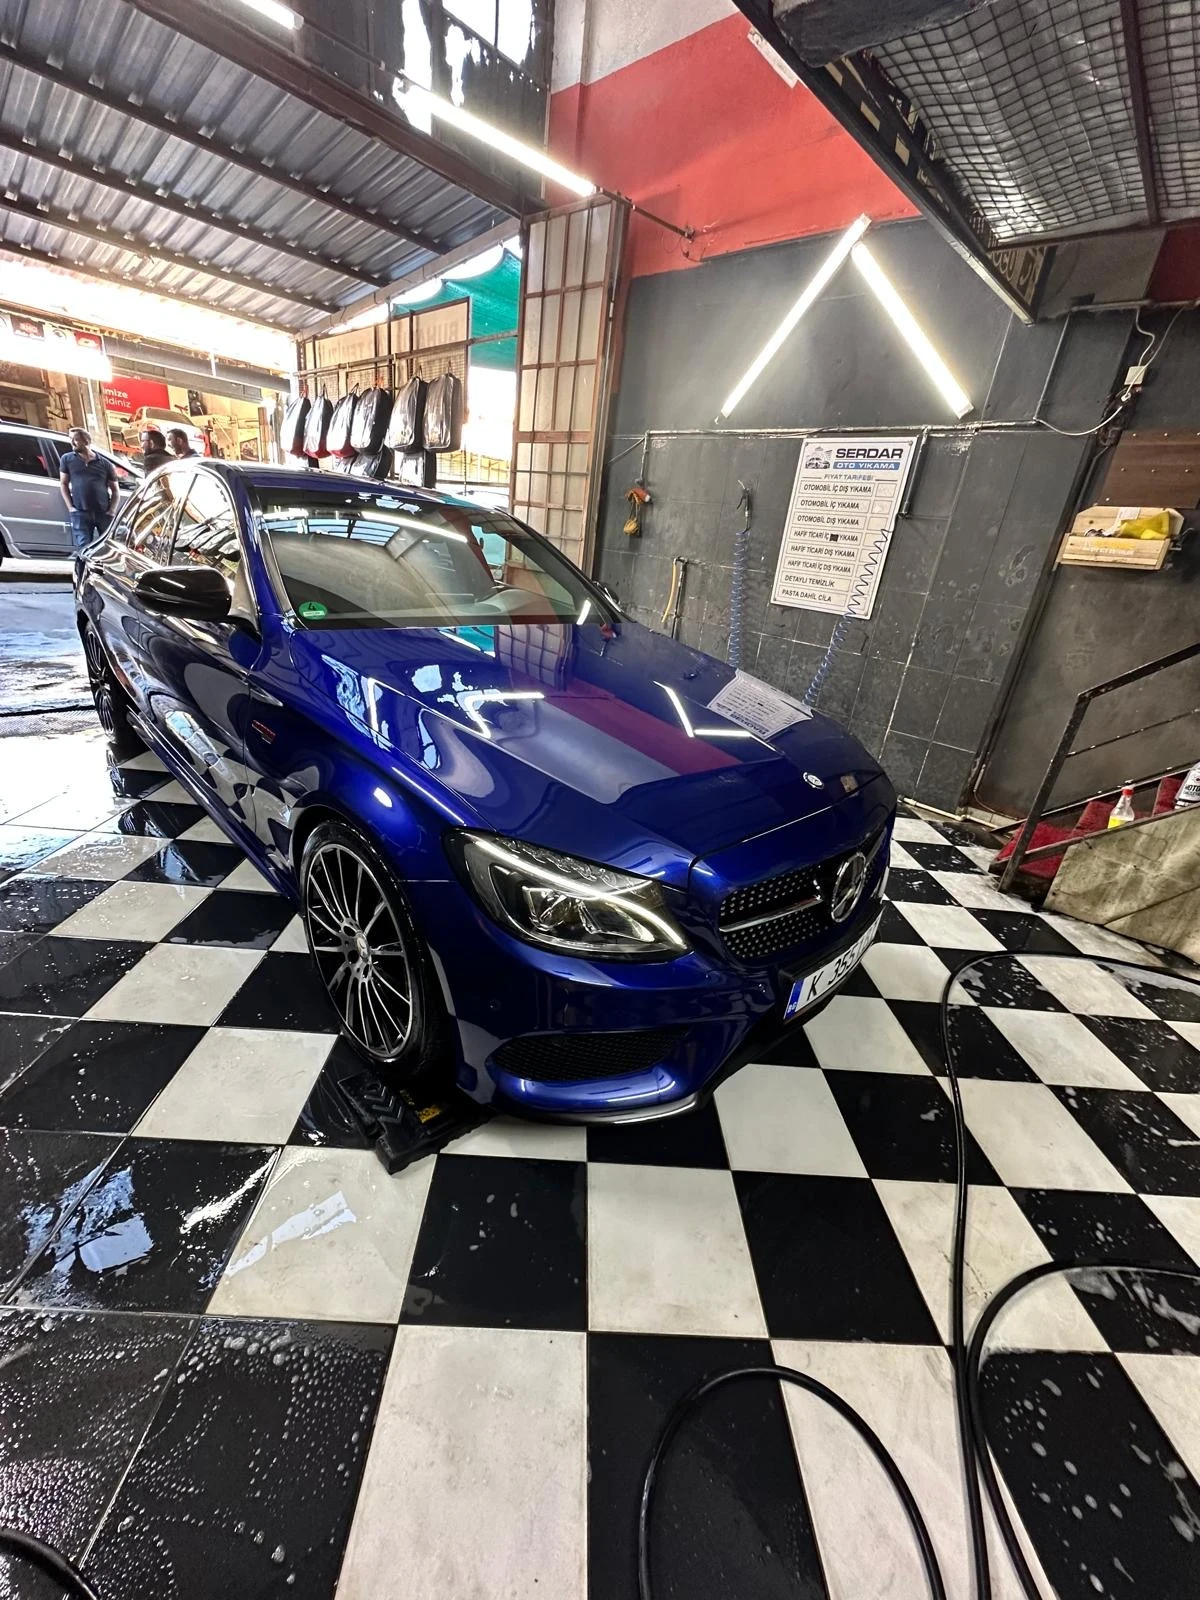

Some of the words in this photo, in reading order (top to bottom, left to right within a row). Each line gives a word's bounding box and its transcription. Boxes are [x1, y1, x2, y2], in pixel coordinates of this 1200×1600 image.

[105, 396, 132, 408] ldiniz
[836, 448, 903, 458] SERDAR
[797, 515, 826, 523] OTOMOBİL
[806, 546, 824, 554] TİCARİ
[832, 564, 851, 572] YIKAMA
[785, 574, 807, 584] DETAYLI
[808, 577, 835, 587] TEMİZLİK
[782, 589, 799, 597] PASTA
[800, 592, 817, 600] DAHİL
[818, 594, 831, 602] CİLA
[806, 970, 824, 1001] K
